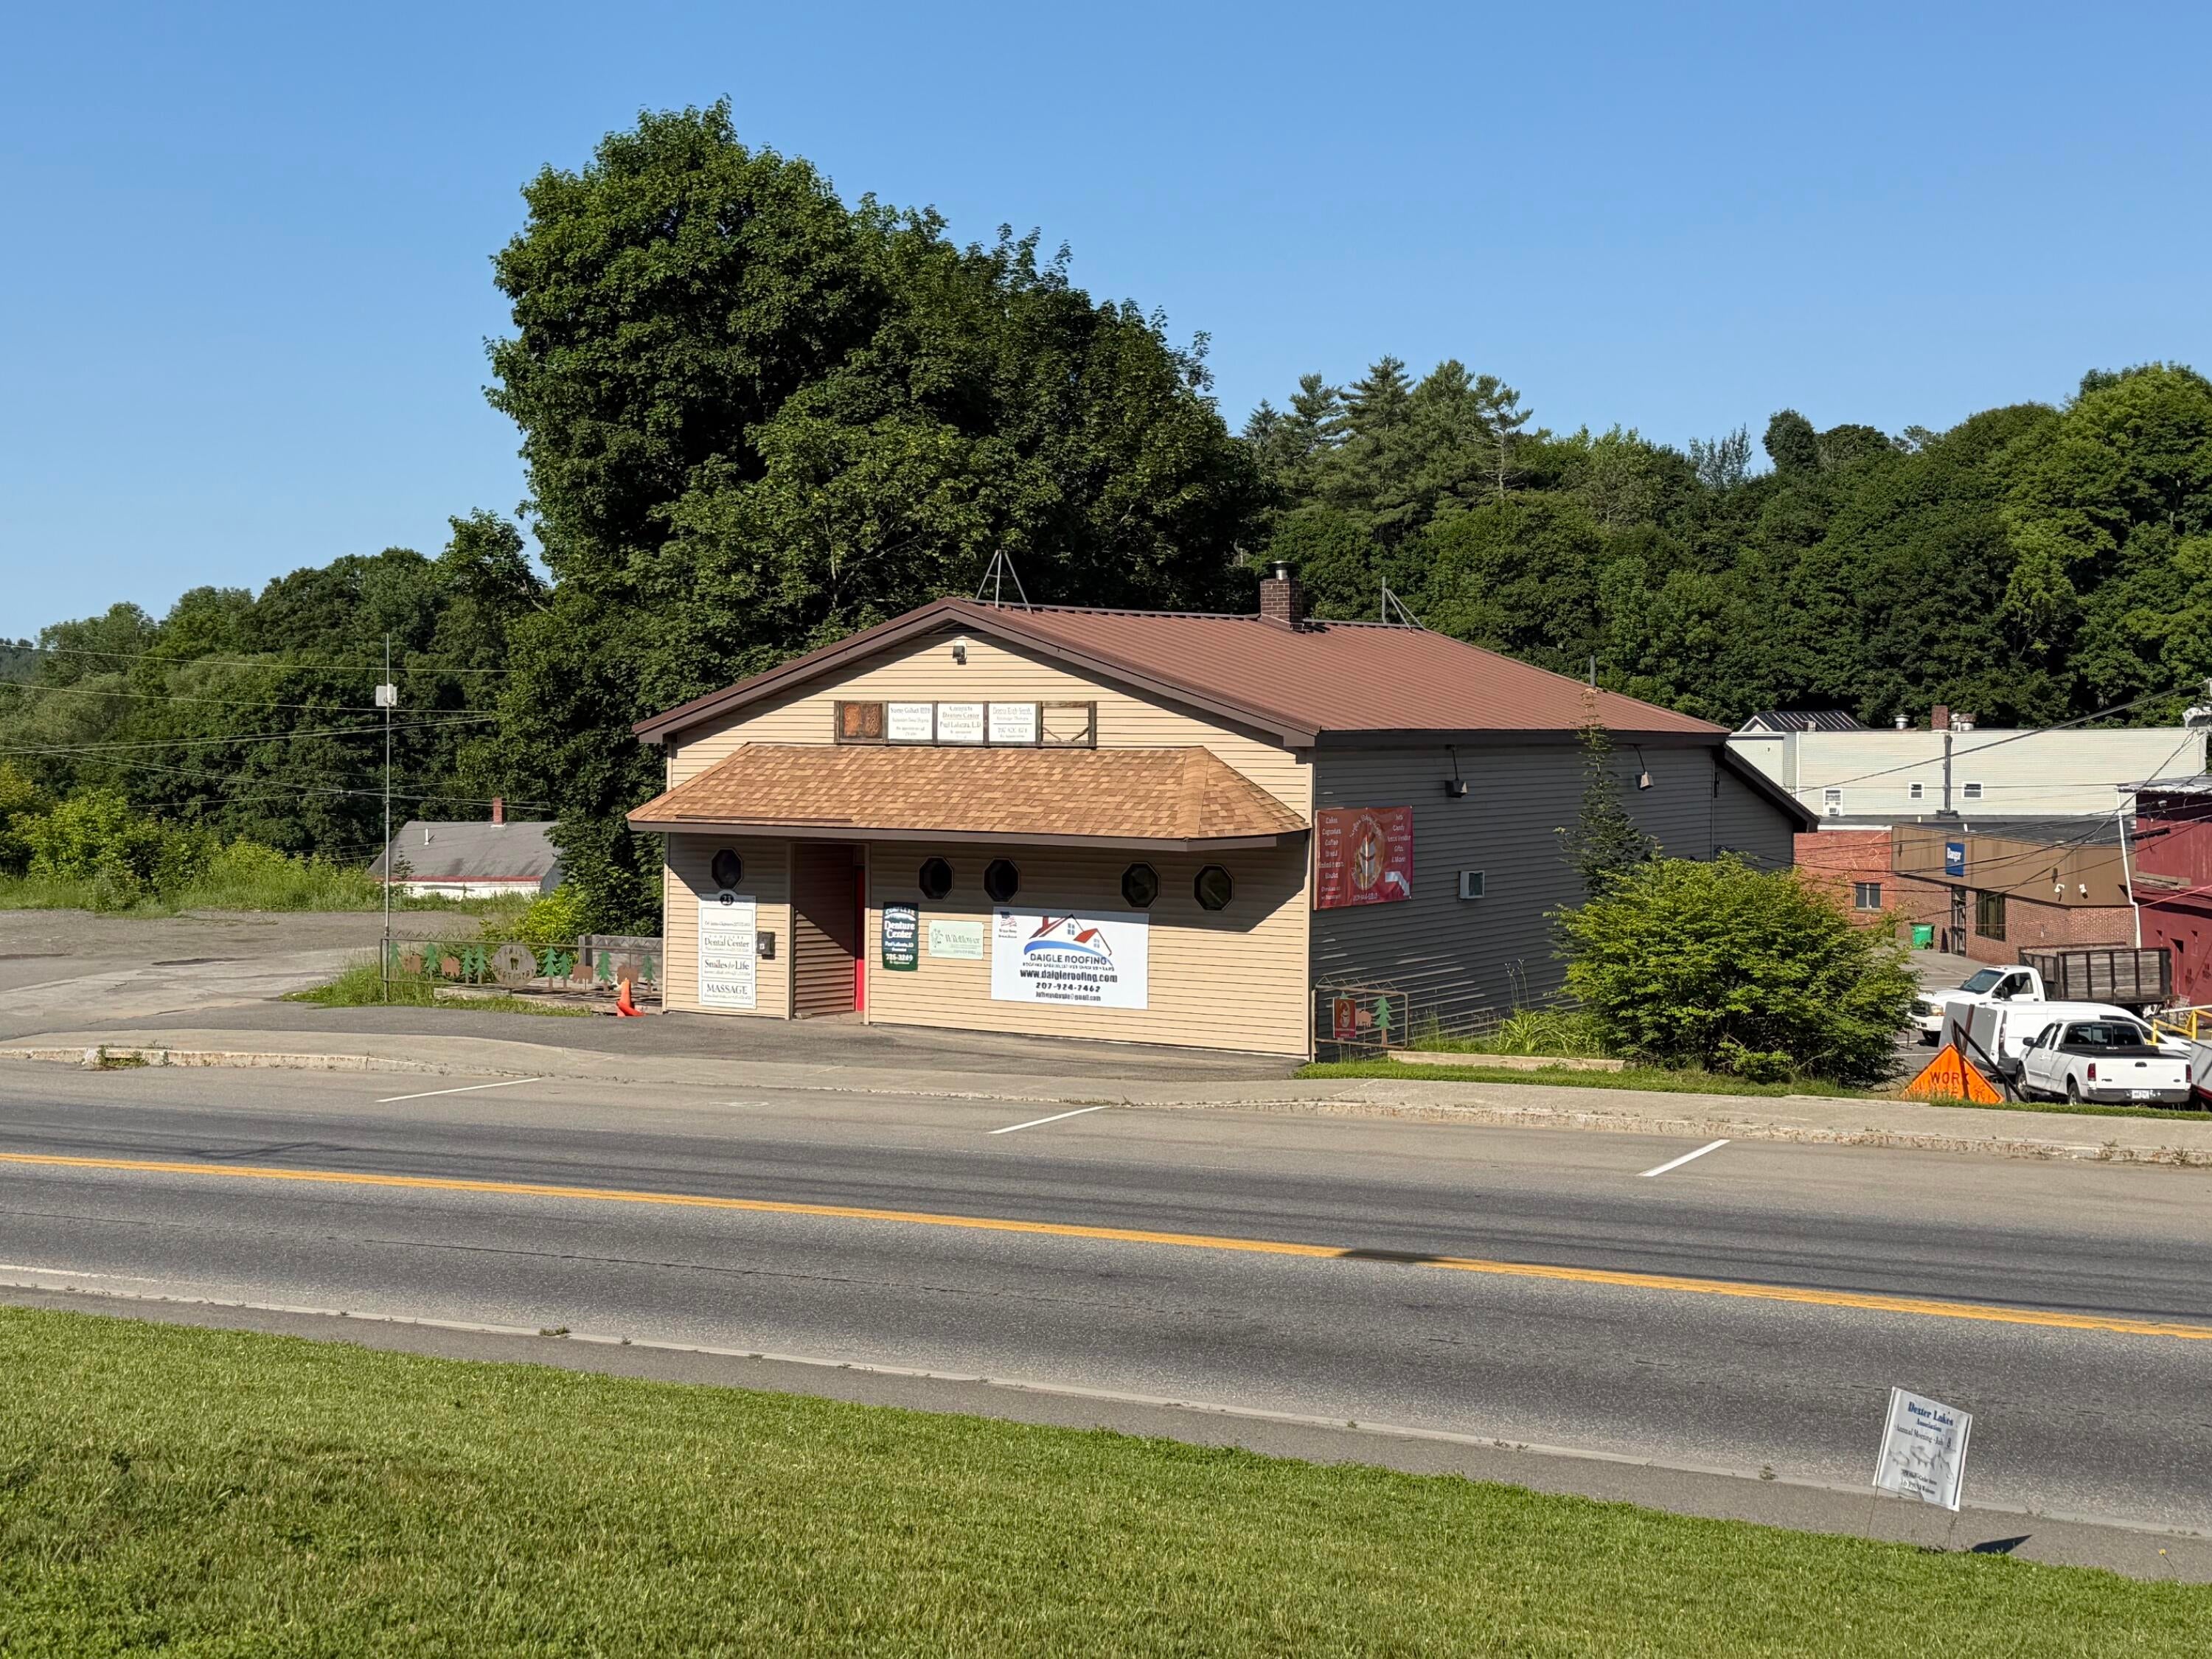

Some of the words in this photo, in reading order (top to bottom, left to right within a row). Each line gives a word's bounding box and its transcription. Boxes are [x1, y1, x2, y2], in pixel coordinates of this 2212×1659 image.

[884, 920, 915, 931] Denture
[886, 929, 913, 939] Center
[727, 939, 750, 947] Center
[704, 959, 728, 969] Smiles
[735, 960, 750, 970] Life
[1030, 953, 1062, 963] DAIGLE
[1065, 955, 1107, 965] ROOFING
[1020, 969, 1118, 983] www.daigleroofing.com
[706, 983, 748, 995] MASSAGE
[1907, 1401, 1932, 1419] Dexter
[1933, 1410, 1954, 1426] Lakes
